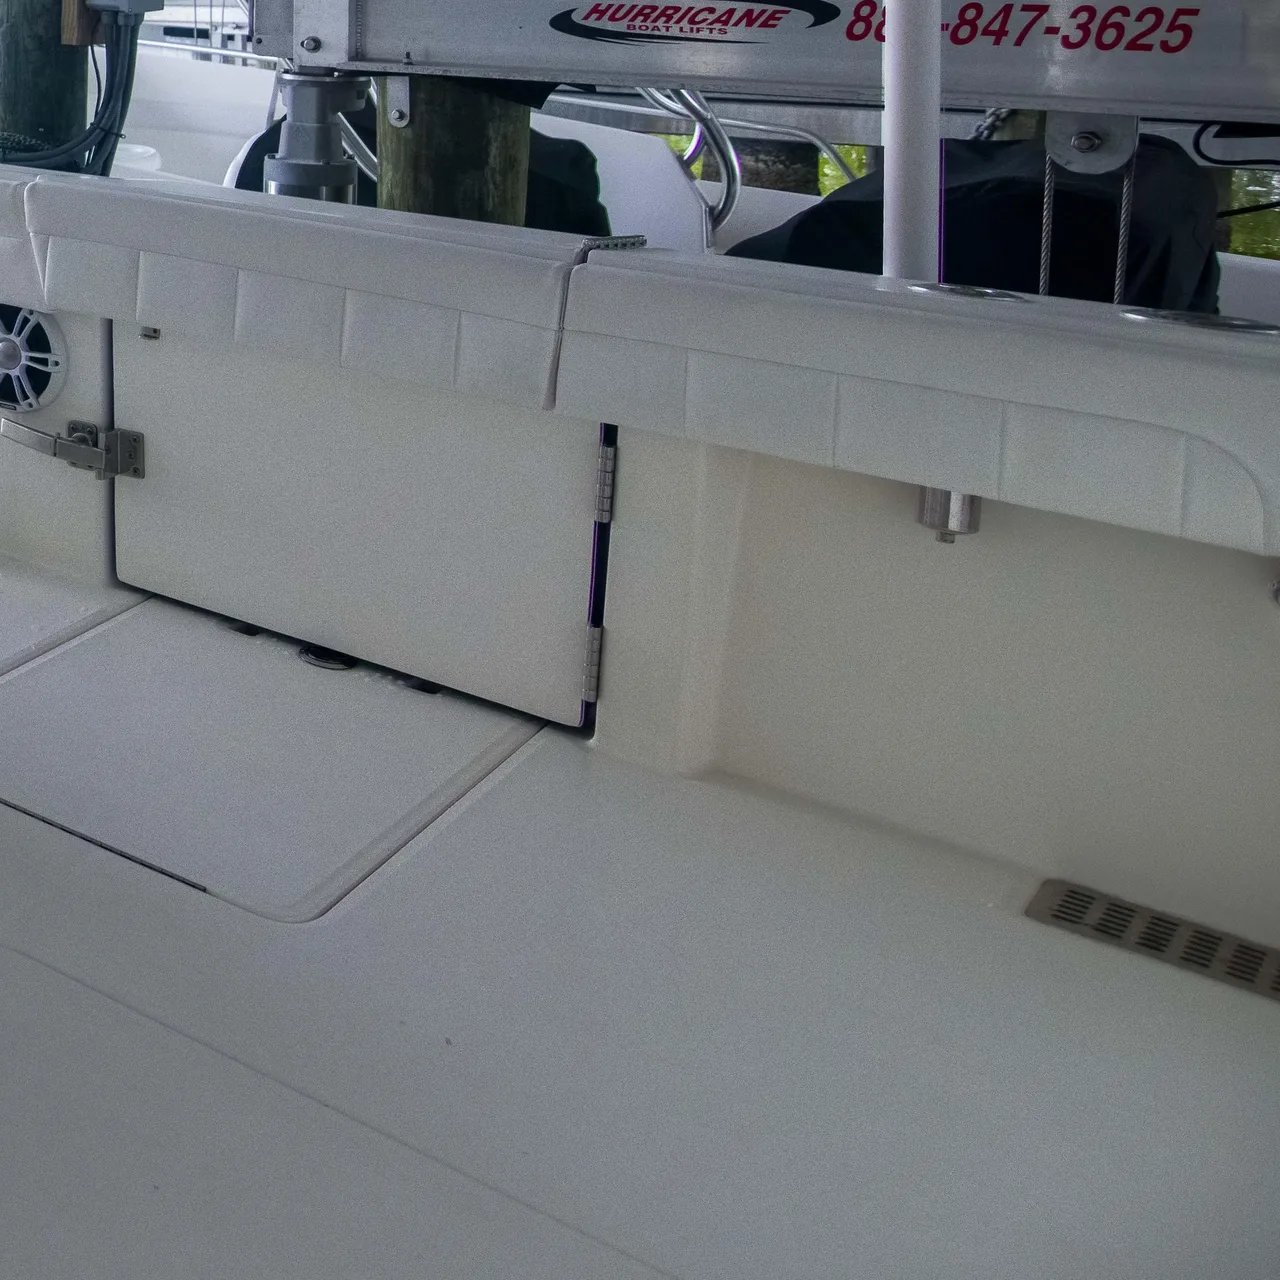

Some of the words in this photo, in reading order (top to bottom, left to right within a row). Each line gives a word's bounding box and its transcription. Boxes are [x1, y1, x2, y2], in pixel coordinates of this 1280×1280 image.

[581, 3, 791, 29] HURRICANE
[626, 23, 673, 33] BOAT
[679, 26, 728, 35] LIFTS
